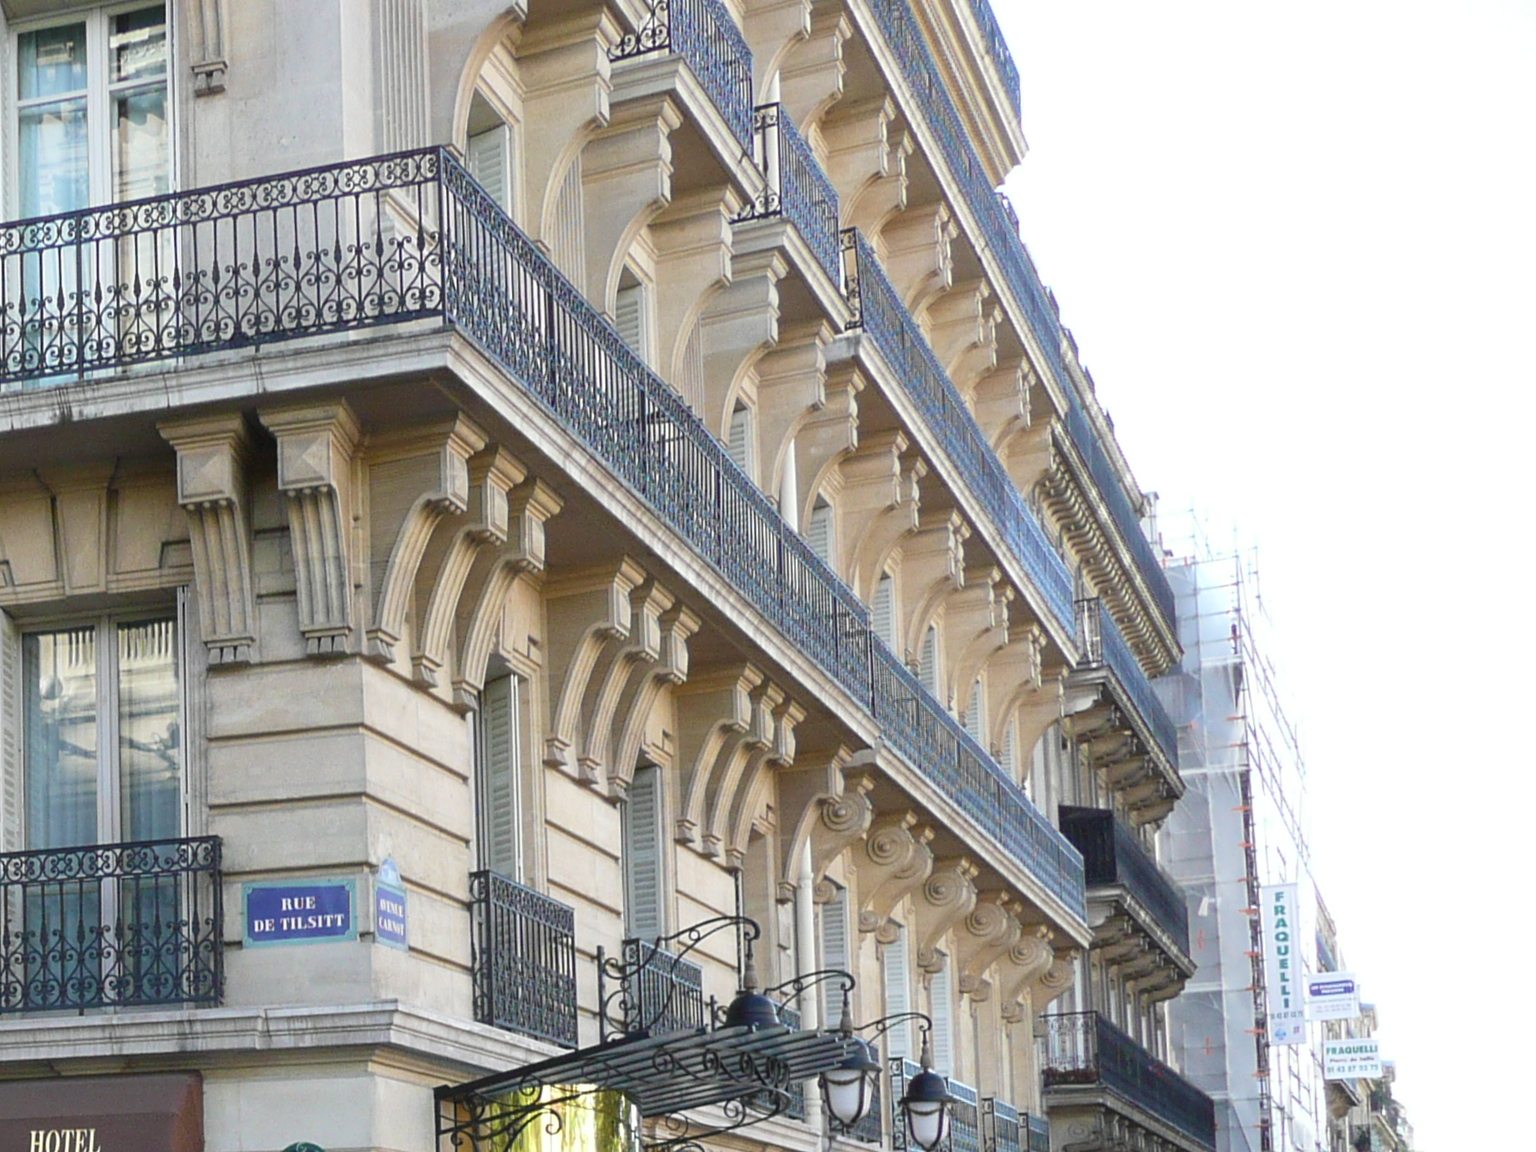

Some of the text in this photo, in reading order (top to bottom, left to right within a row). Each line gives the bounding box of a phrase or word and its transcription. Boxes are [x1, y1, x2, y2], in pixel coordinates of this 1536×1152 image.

[281, 896, 316, 911] RUE
[379, 898, 404, 918] AVENUE
[254, 914, 344, 933] DE TILSITT
[379, 916, 404, 936] CARNOT
[1274, 892, 1290, 1009] FRAQUELLI
[1326, 1045, 1378, 1055] FRAQUELLI
